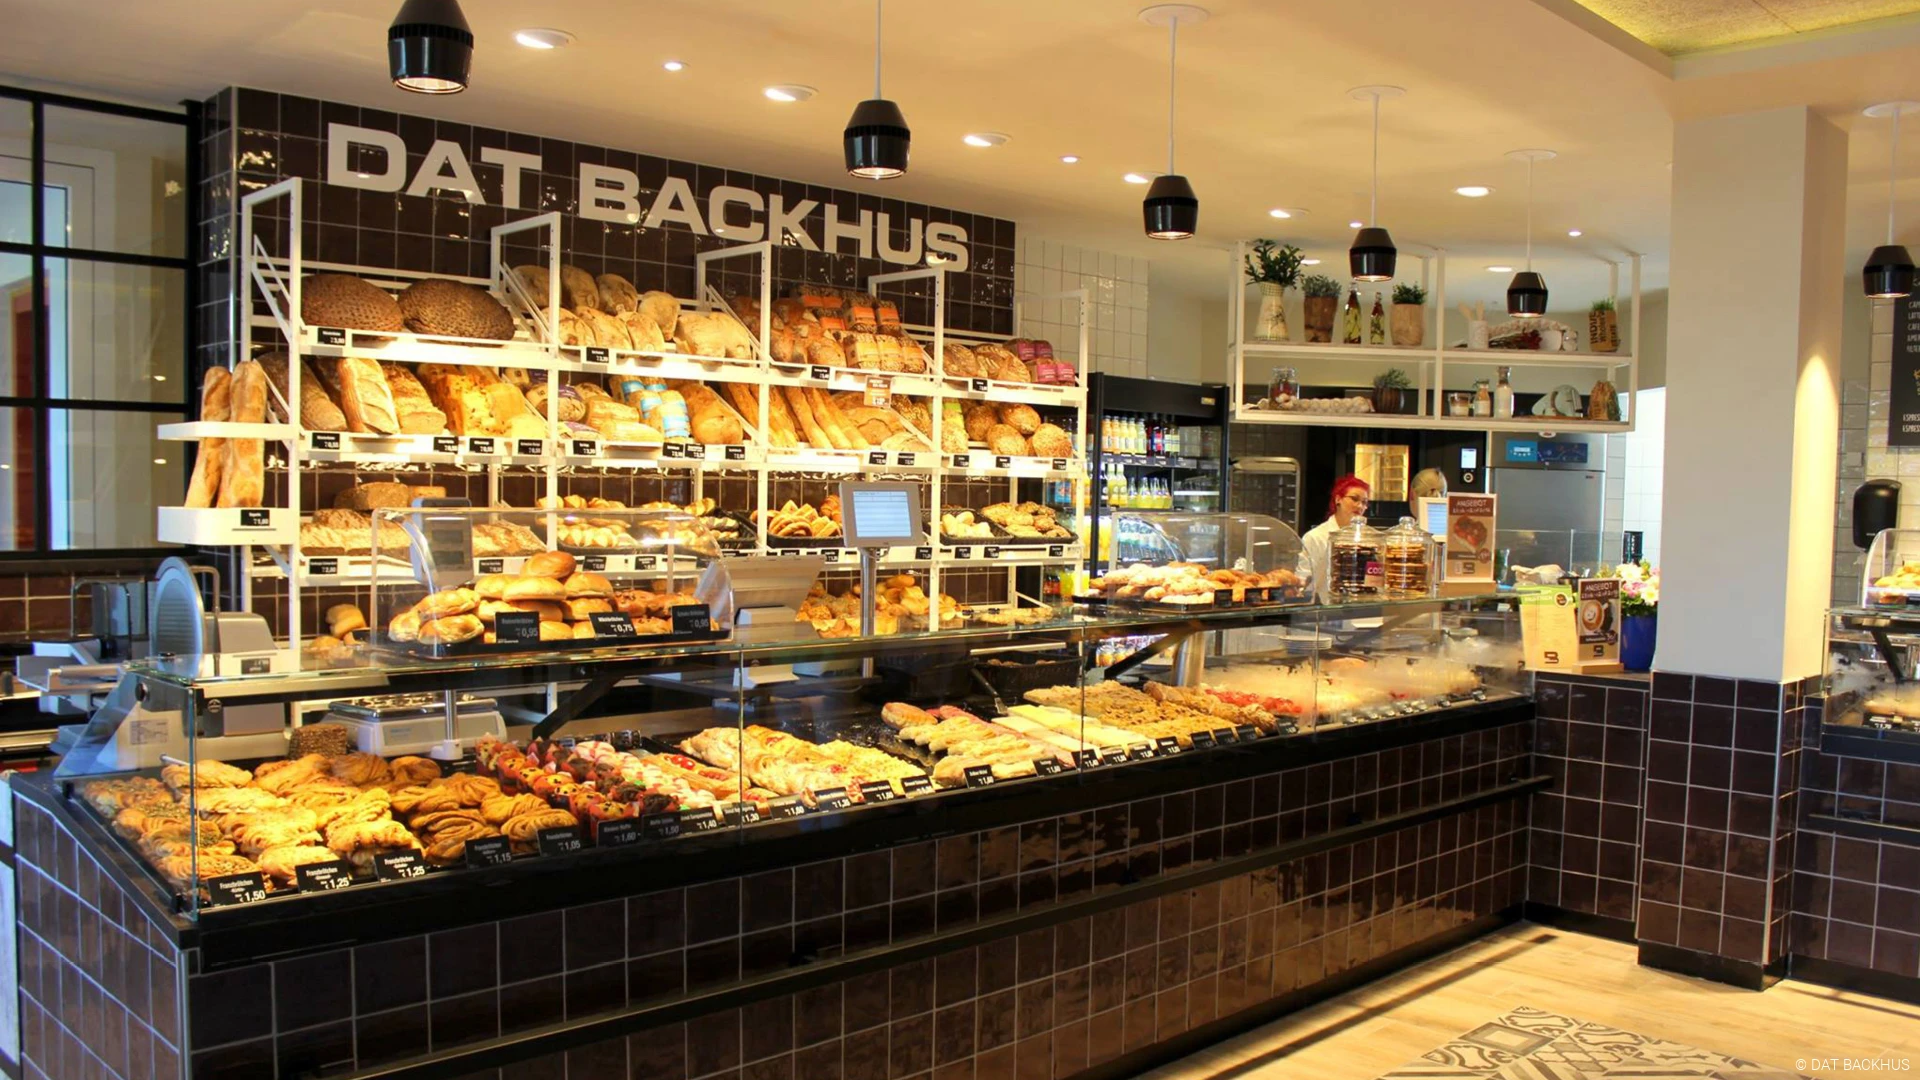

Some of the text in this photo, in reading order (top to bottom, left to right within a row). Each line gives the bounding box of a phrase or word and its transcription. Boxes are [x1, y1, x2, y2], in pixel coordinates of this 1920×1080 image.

[328, 122, 969, 272] DAT BACKHUS
[1456, 499, 1487, 507] ANGEBOT
[1585, 582, 1613, 591] ANGEBOT
[617, 623, 633, 633] 0,75
[494, 852, 512, 864] 1,15
[406, 865, 425, 878] 1,25
[329, 877, 349, 889] 1,25
[244, 890, 266, 903] 1,50
